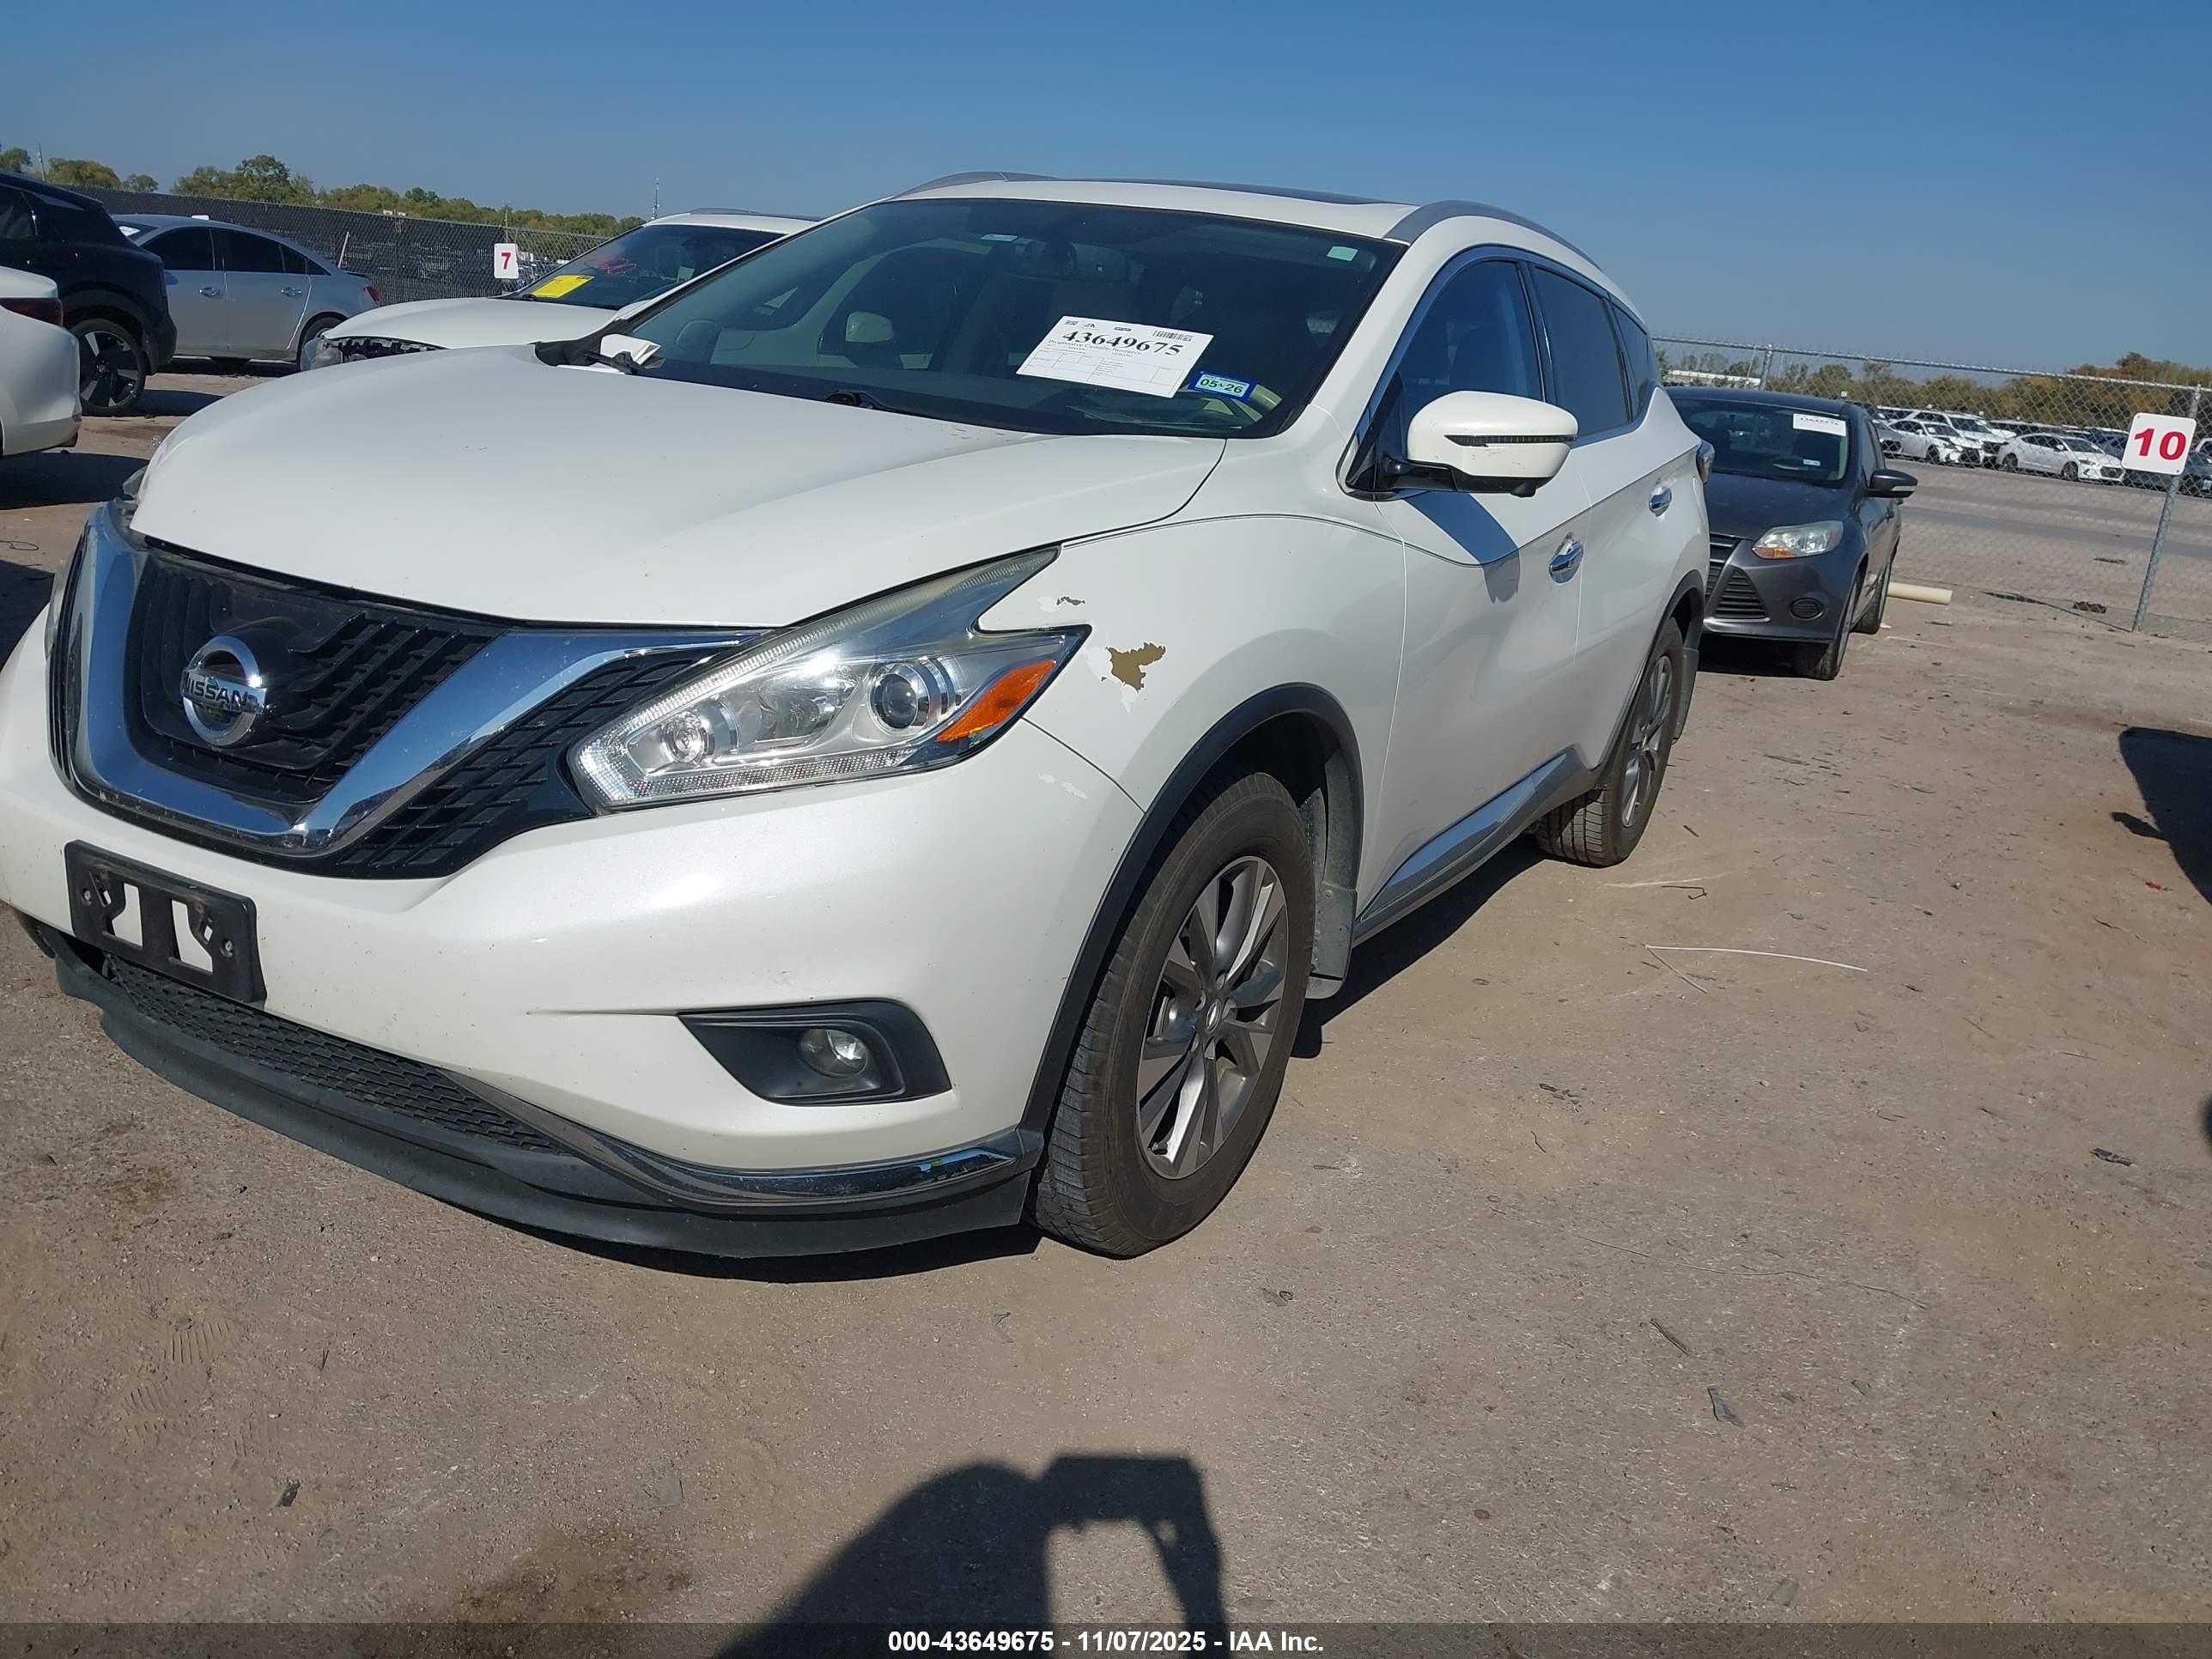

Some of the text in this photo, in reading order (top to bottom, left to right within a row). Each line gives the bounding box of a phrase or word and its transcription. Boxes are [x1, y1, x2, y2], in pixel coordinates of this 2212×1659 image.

[501, 252, 512, 270] 7
[1048, 339, 1084, 348] Progressive
[1061, 331, 1184, 356] 43649675
[2134, 428, 2187, 460] 10
[183, 671, 248, 707] NISSAN
